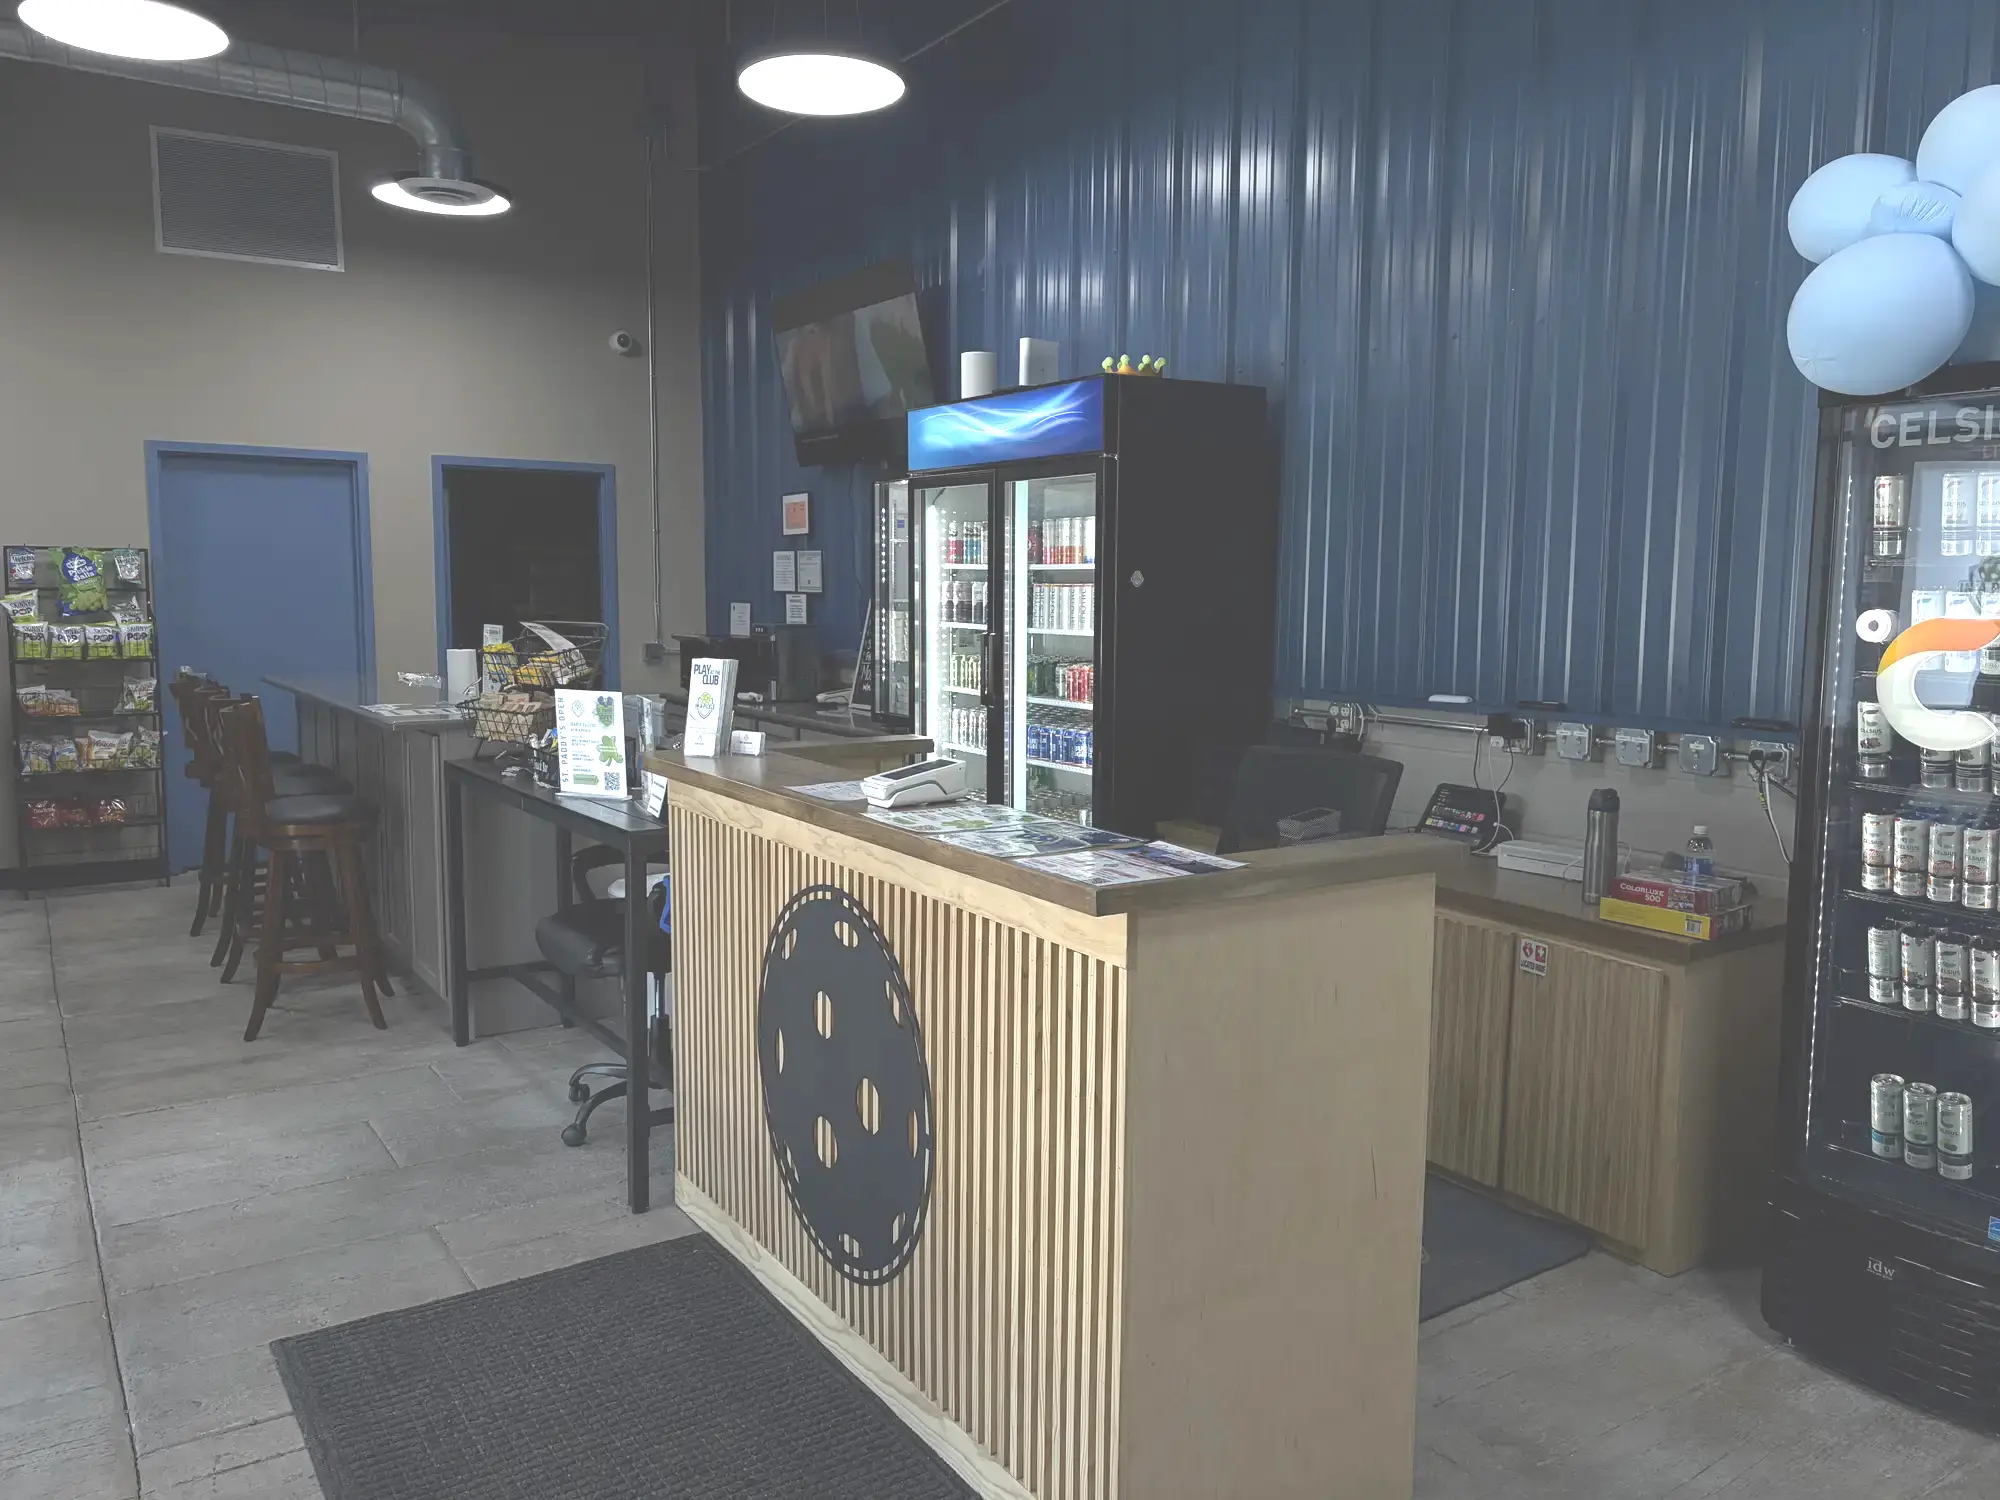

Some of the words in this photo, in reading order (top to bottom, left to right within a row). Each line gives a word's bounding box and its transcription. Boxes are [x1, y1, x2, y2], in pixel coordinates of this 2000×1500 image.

[1870, 404, 2000, 449] CELSI
[9, 599, 32, 608] SKINNY
[11, 607, 33, 616] POP
[23, 633, 44, 641] POP
[94, 634, 114, 642] POP
[127, 632, 148, 641] POP
[693, 664, 712, 674] PLAY
[702, 675, 719, 685] CLUB
[558, 697, 566, 721] OPEN
[559, 725, 568, 765] PADDY'S
[1934, 849, 1957, 857] CELSIUS
[1620, 882, 1665, 897] COLORLUXE
[1645, 893, 1661, 903] 500
